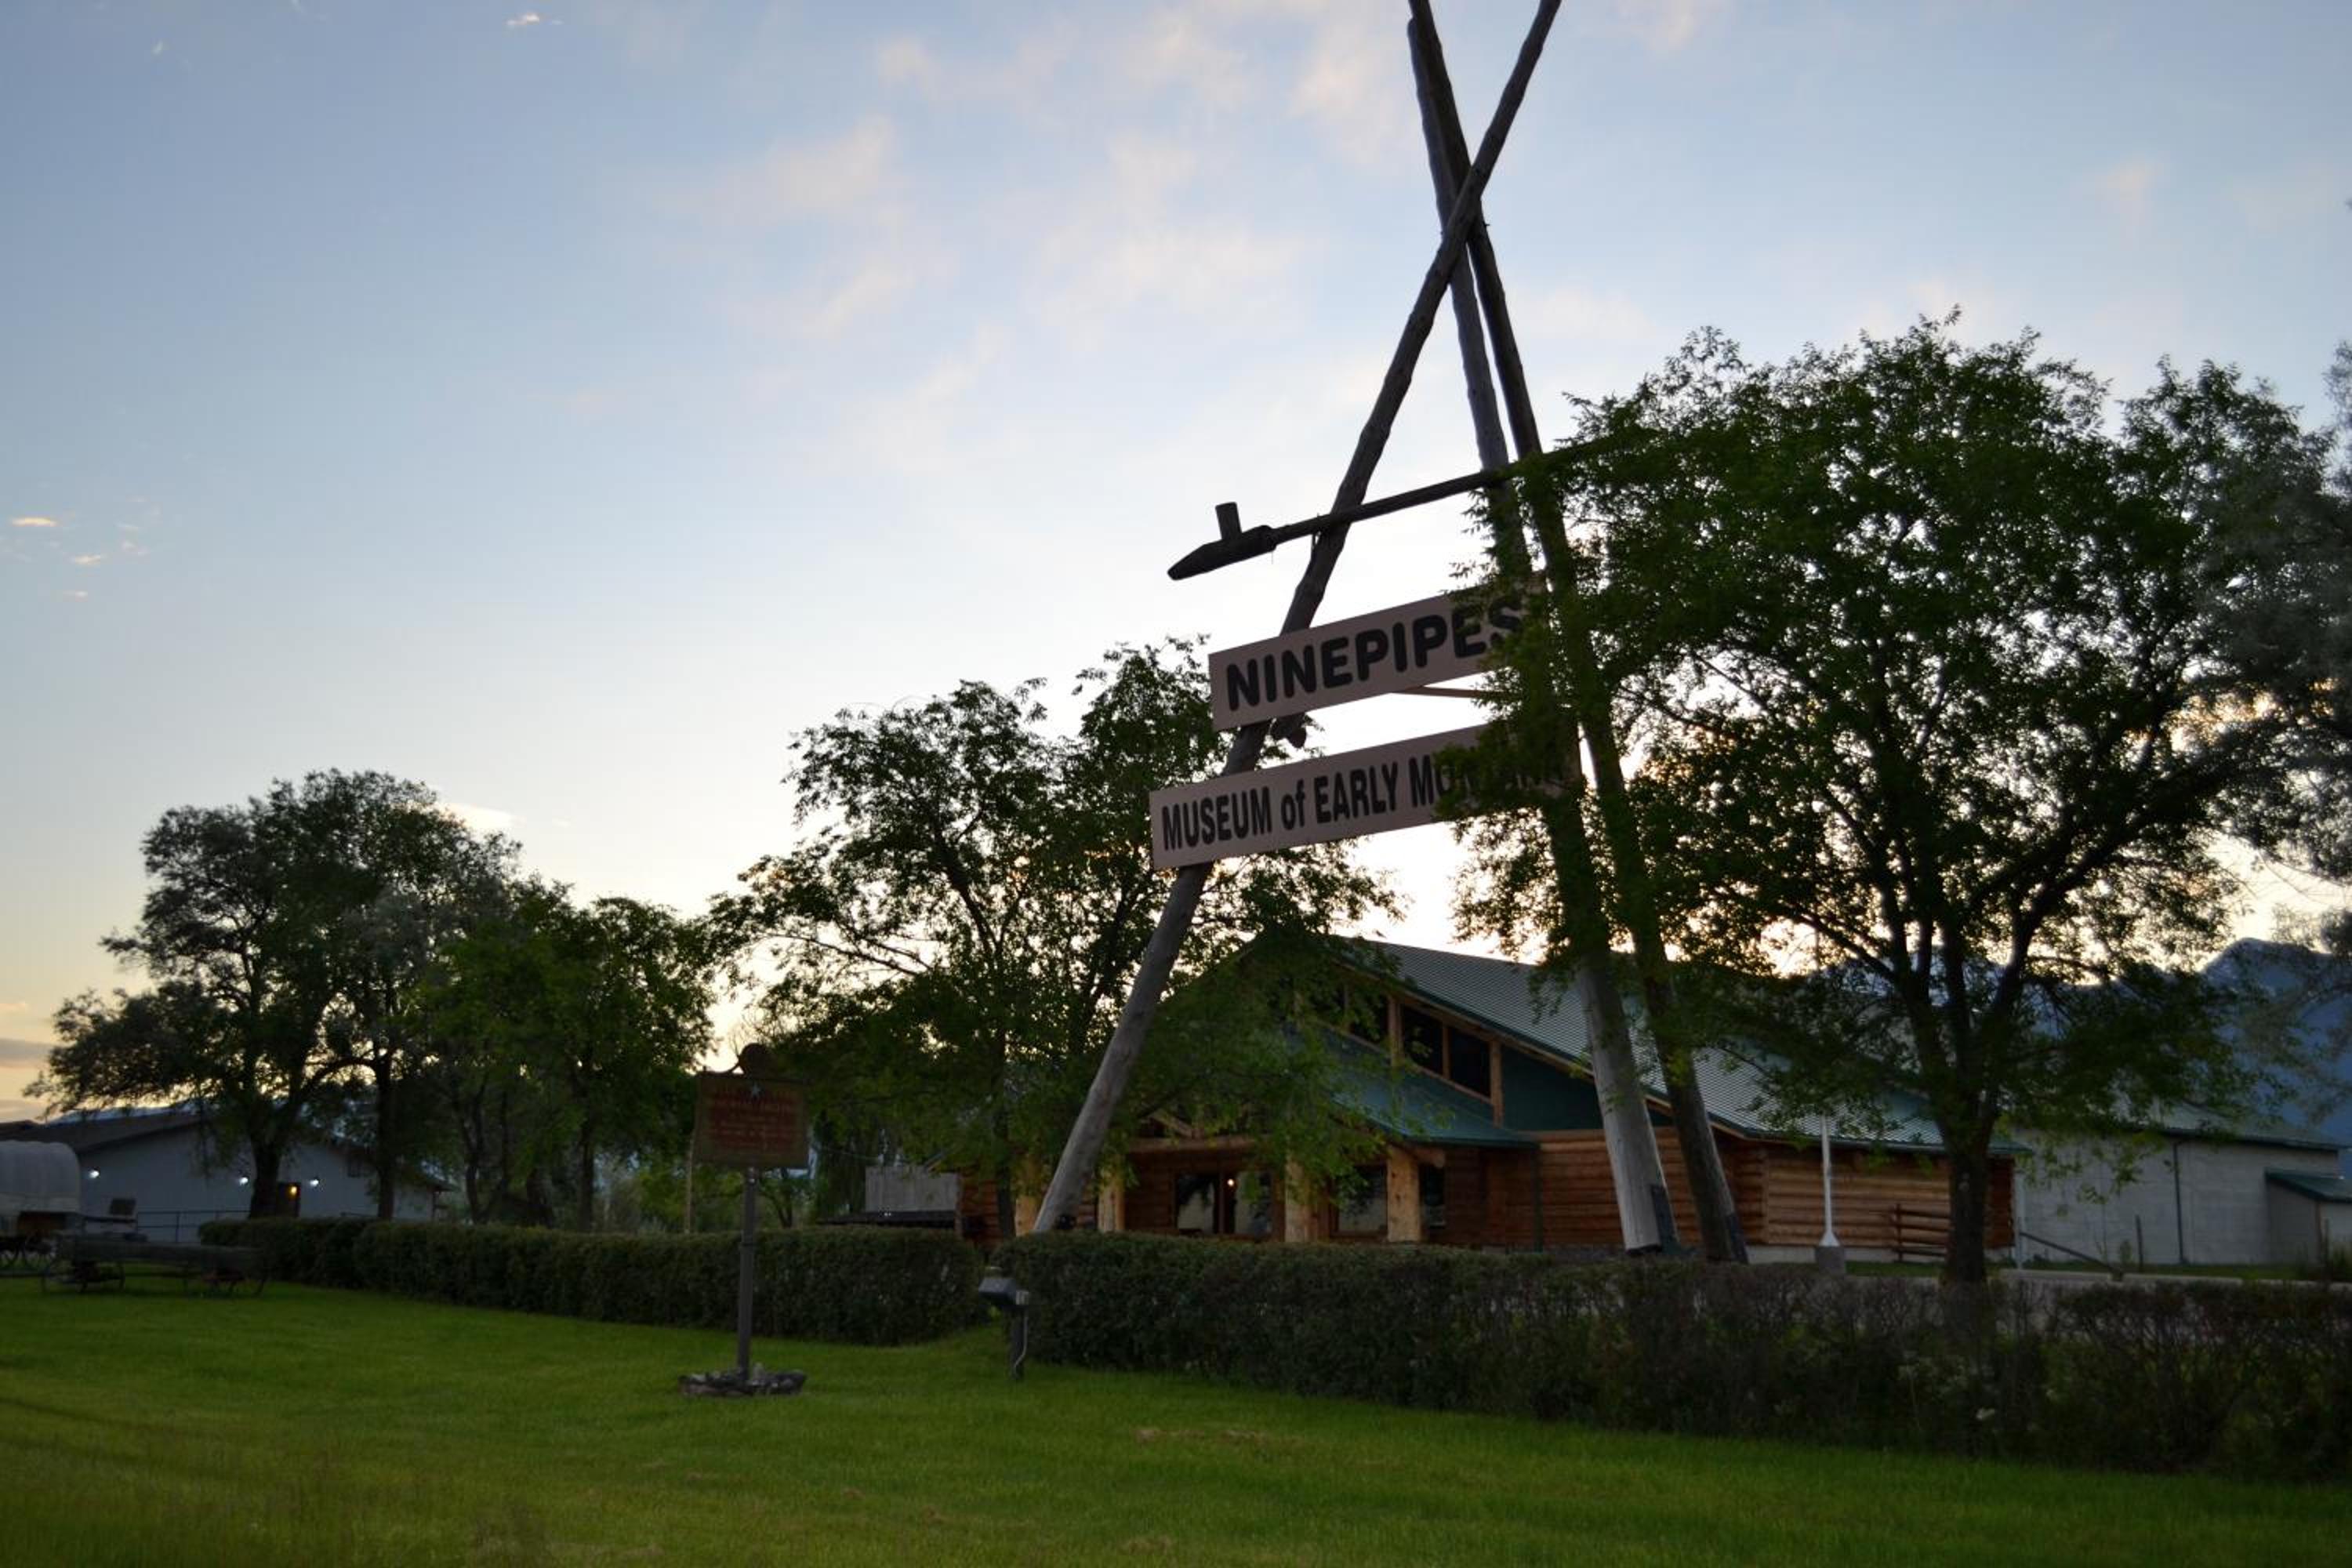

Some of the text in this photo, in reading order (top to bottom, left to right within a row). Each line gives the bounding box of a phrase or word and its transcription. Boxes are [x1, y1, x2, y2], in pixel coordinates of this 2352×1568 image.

[1226, 598, 1524, 711] NINEPIPES
[1162, 786, 1272, 850] MUSEUM
[1281, 779, 1305, 830] of
[1315, 761, 1399, 823] EARLY
